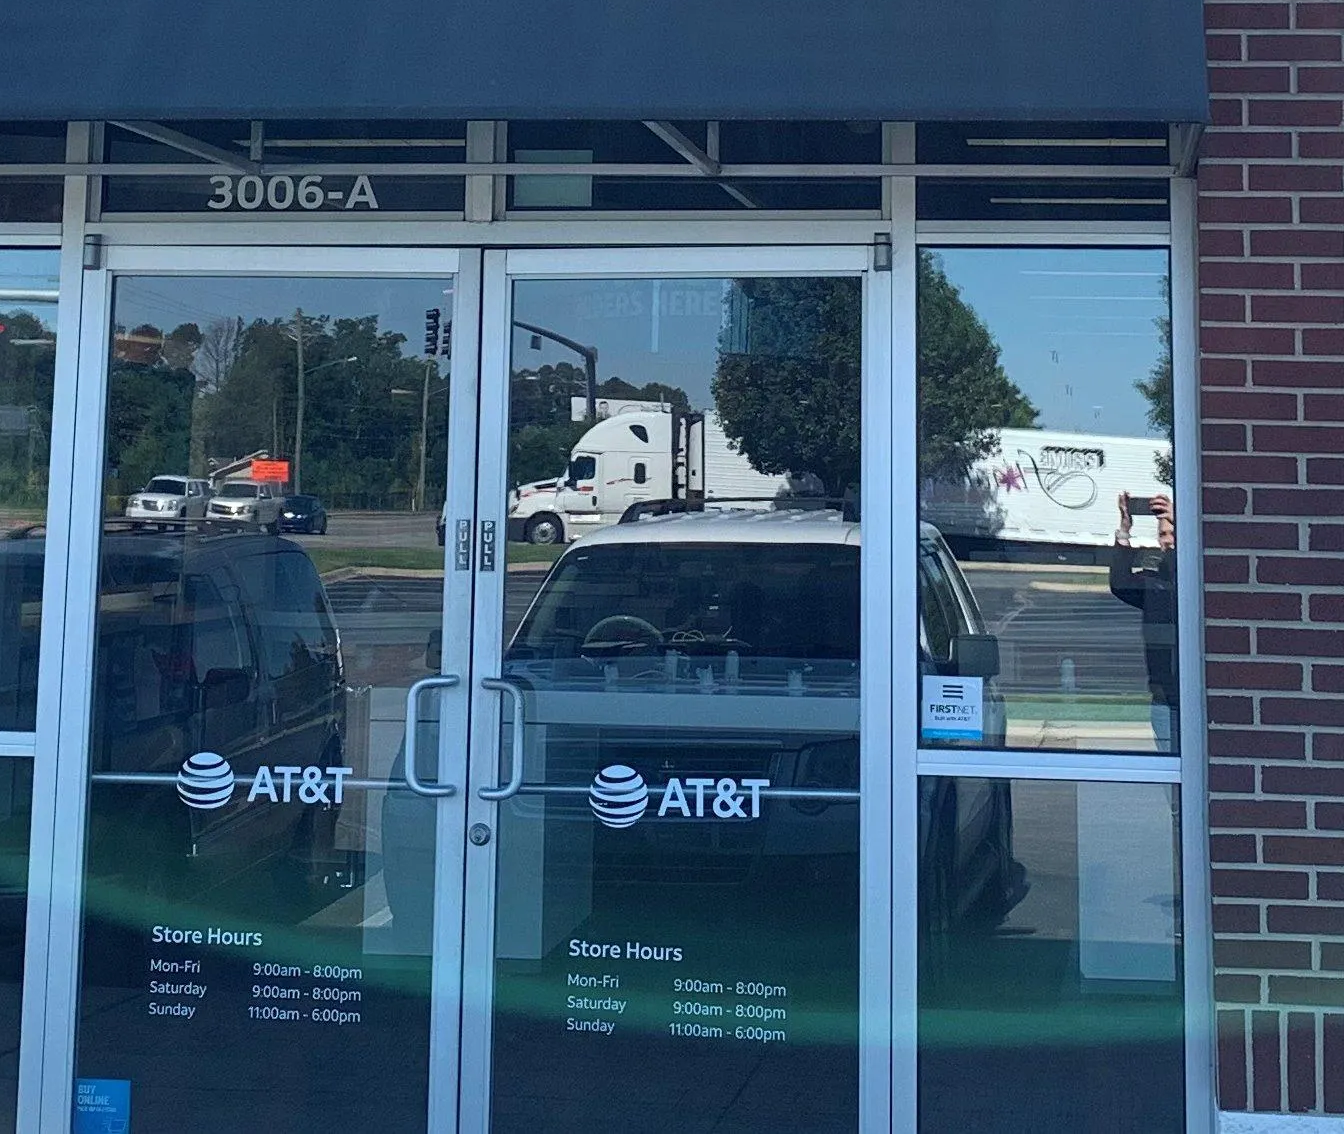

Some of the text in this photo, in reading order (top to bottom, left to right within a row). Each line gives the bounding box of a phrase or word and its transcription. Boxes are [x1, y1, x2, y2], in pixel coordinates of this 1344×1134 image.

[207, 175, 379, 209] 3006-A
[459, 521, 467, 565] PULL
[484, 521, 493, 566] PULL
[247, 765, 353, 804] AT&T
[658, 777, 770, 818] AT&T
[152, 926, 263, 946] Store Hours
[569, 939, 683, 961] Store Hours
[150, 959, 201, 973] Mon-Fri
[253, 963, 301, 977] 9:00am
[313, 965, 363, 981] 8:00pm
[150, 981, 207, 998] Saturday
[252, 985, 300, 999] 9:00am
[312, 988, 361, 1003] 8:00pm
[567, 974, 619, 988] Mon-Fri
[674, 979, 723, 994] 9:00am
[736, 982, 786, 998] 8:00pm
[148, 1003, 195, 1019] Sunday
[248, 1007, 300, 1021] 11:00am
[311, 1009, 361, 1025] 6:00pm
[567, 996, 627, 1013] Saturday
[673, 1001, 722, 1016] 9:00am
[735, 1005, 786, 1021] 8:00pm
[566, 1018, 615, 1035] Sunday
[669, 1023, 722, 1038] 11:00am
[735, 1027, 785, 1043] 6:00pm
[77, 1095, 110, 1105] ONLINE
[78, 1085, 96, 1094] BUY
